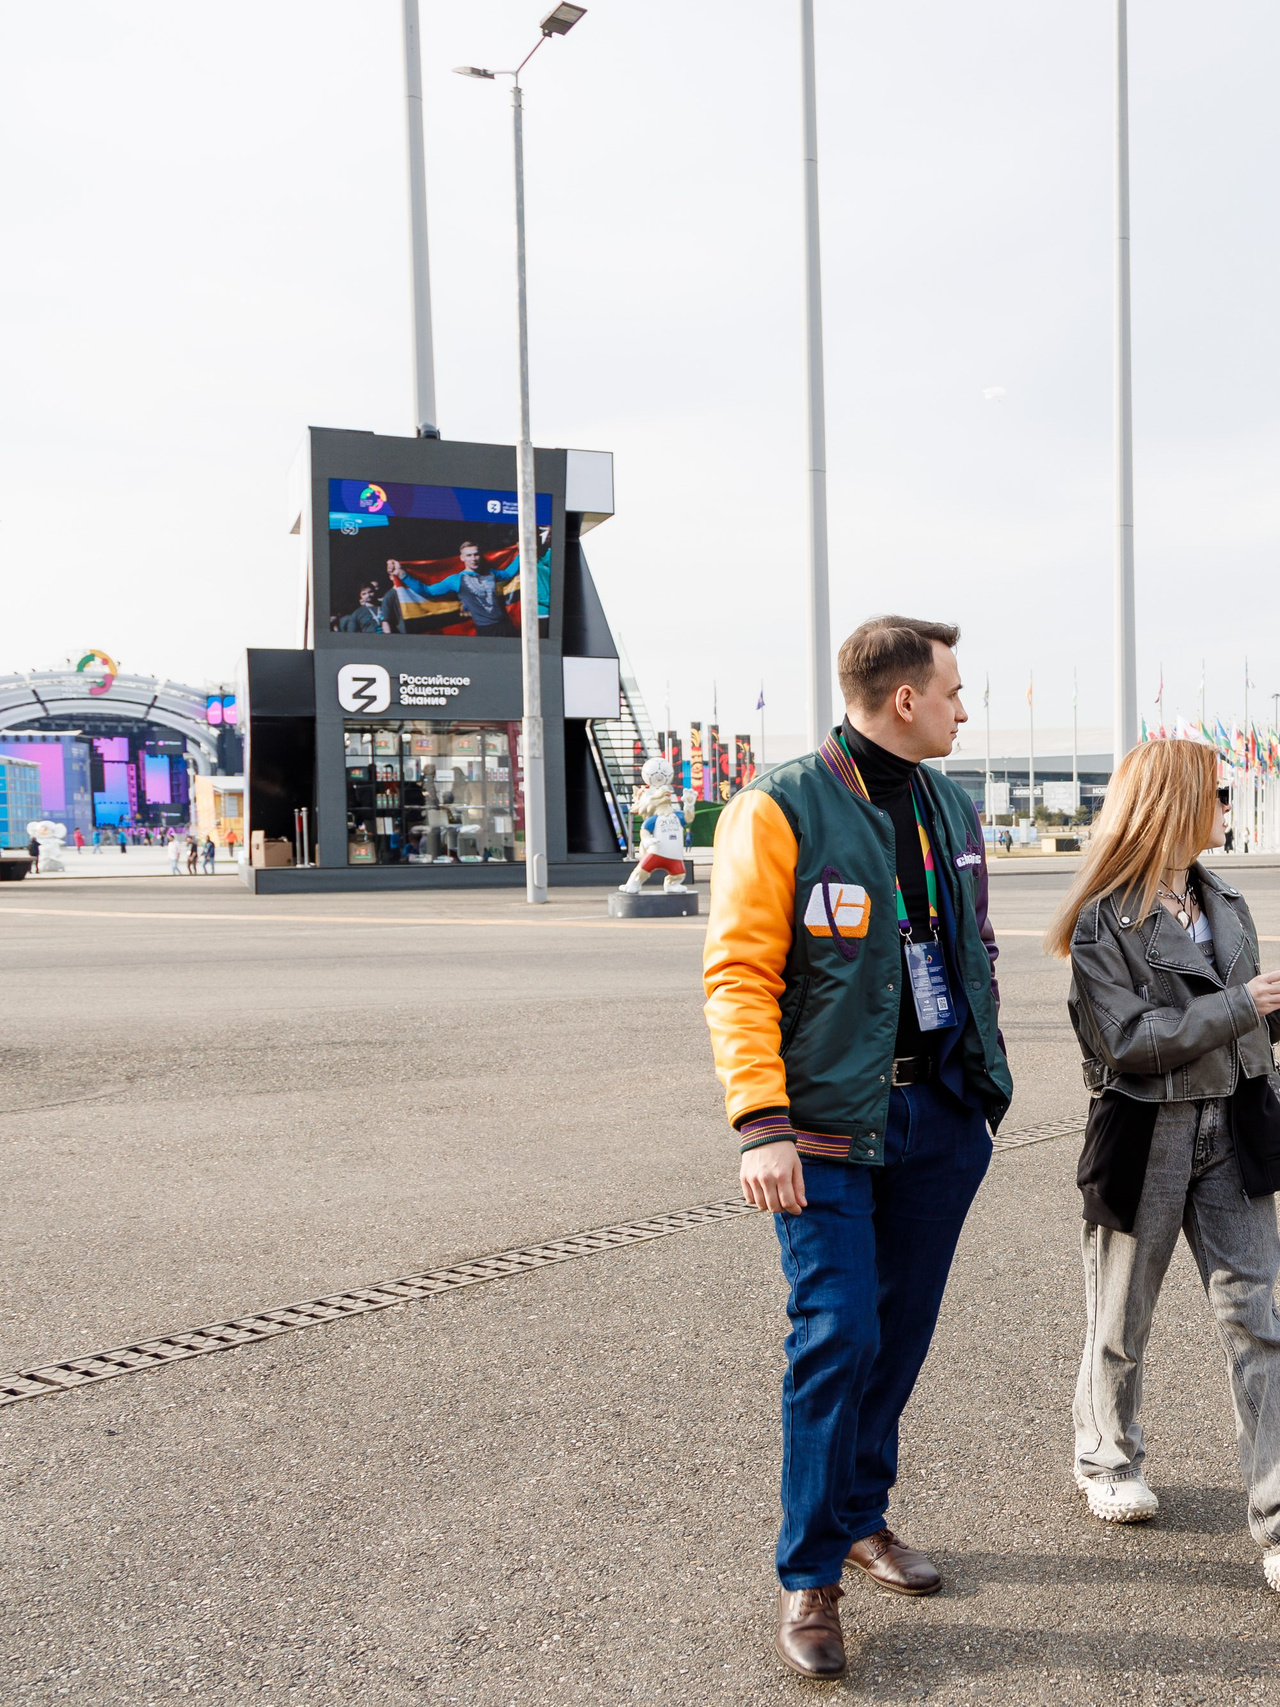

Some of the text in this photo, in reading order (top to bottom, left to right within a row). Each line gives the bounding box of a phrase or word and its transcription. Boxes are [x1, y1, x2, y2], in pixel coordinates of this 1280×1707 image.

[400, 674, 470, 686] Российское
[400, 685, 459, 696] общество
[400, 695, 447, 706] Знание
